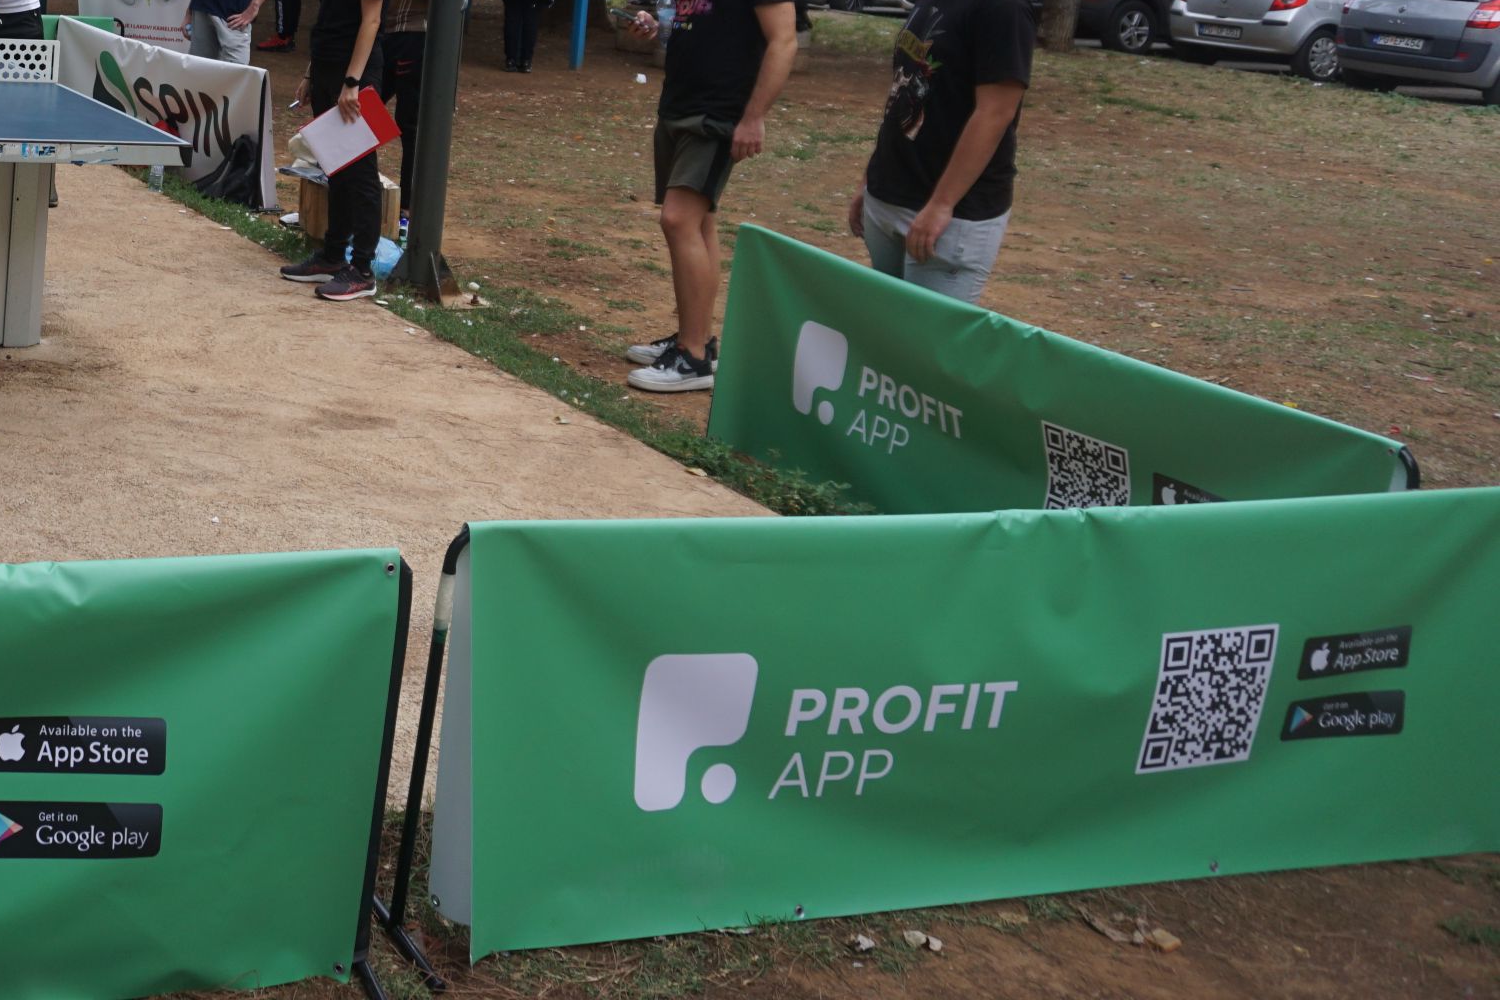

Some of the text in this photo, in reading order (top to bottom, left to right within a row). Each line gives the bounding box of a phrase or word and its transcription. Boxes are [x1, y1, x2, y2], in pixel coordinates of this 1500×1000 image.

[133, 77, 233, 160] SPIN
[857, 366, 963, 440] PROFIT
[846, 409, 910, 455] APP
[1333, 647, 1399, 671] App Store
[784, 680, 1019, 737] PROFIT
[1318, 709, 1397, 732] Google play
[39, 724, 142, 737] Available on the
[37, 740, 149, 767] App Store
[768, 749, 895, 800] APP
[38, 812, 79, 822] Get it on
[35, 825, 150, 852] Google play
